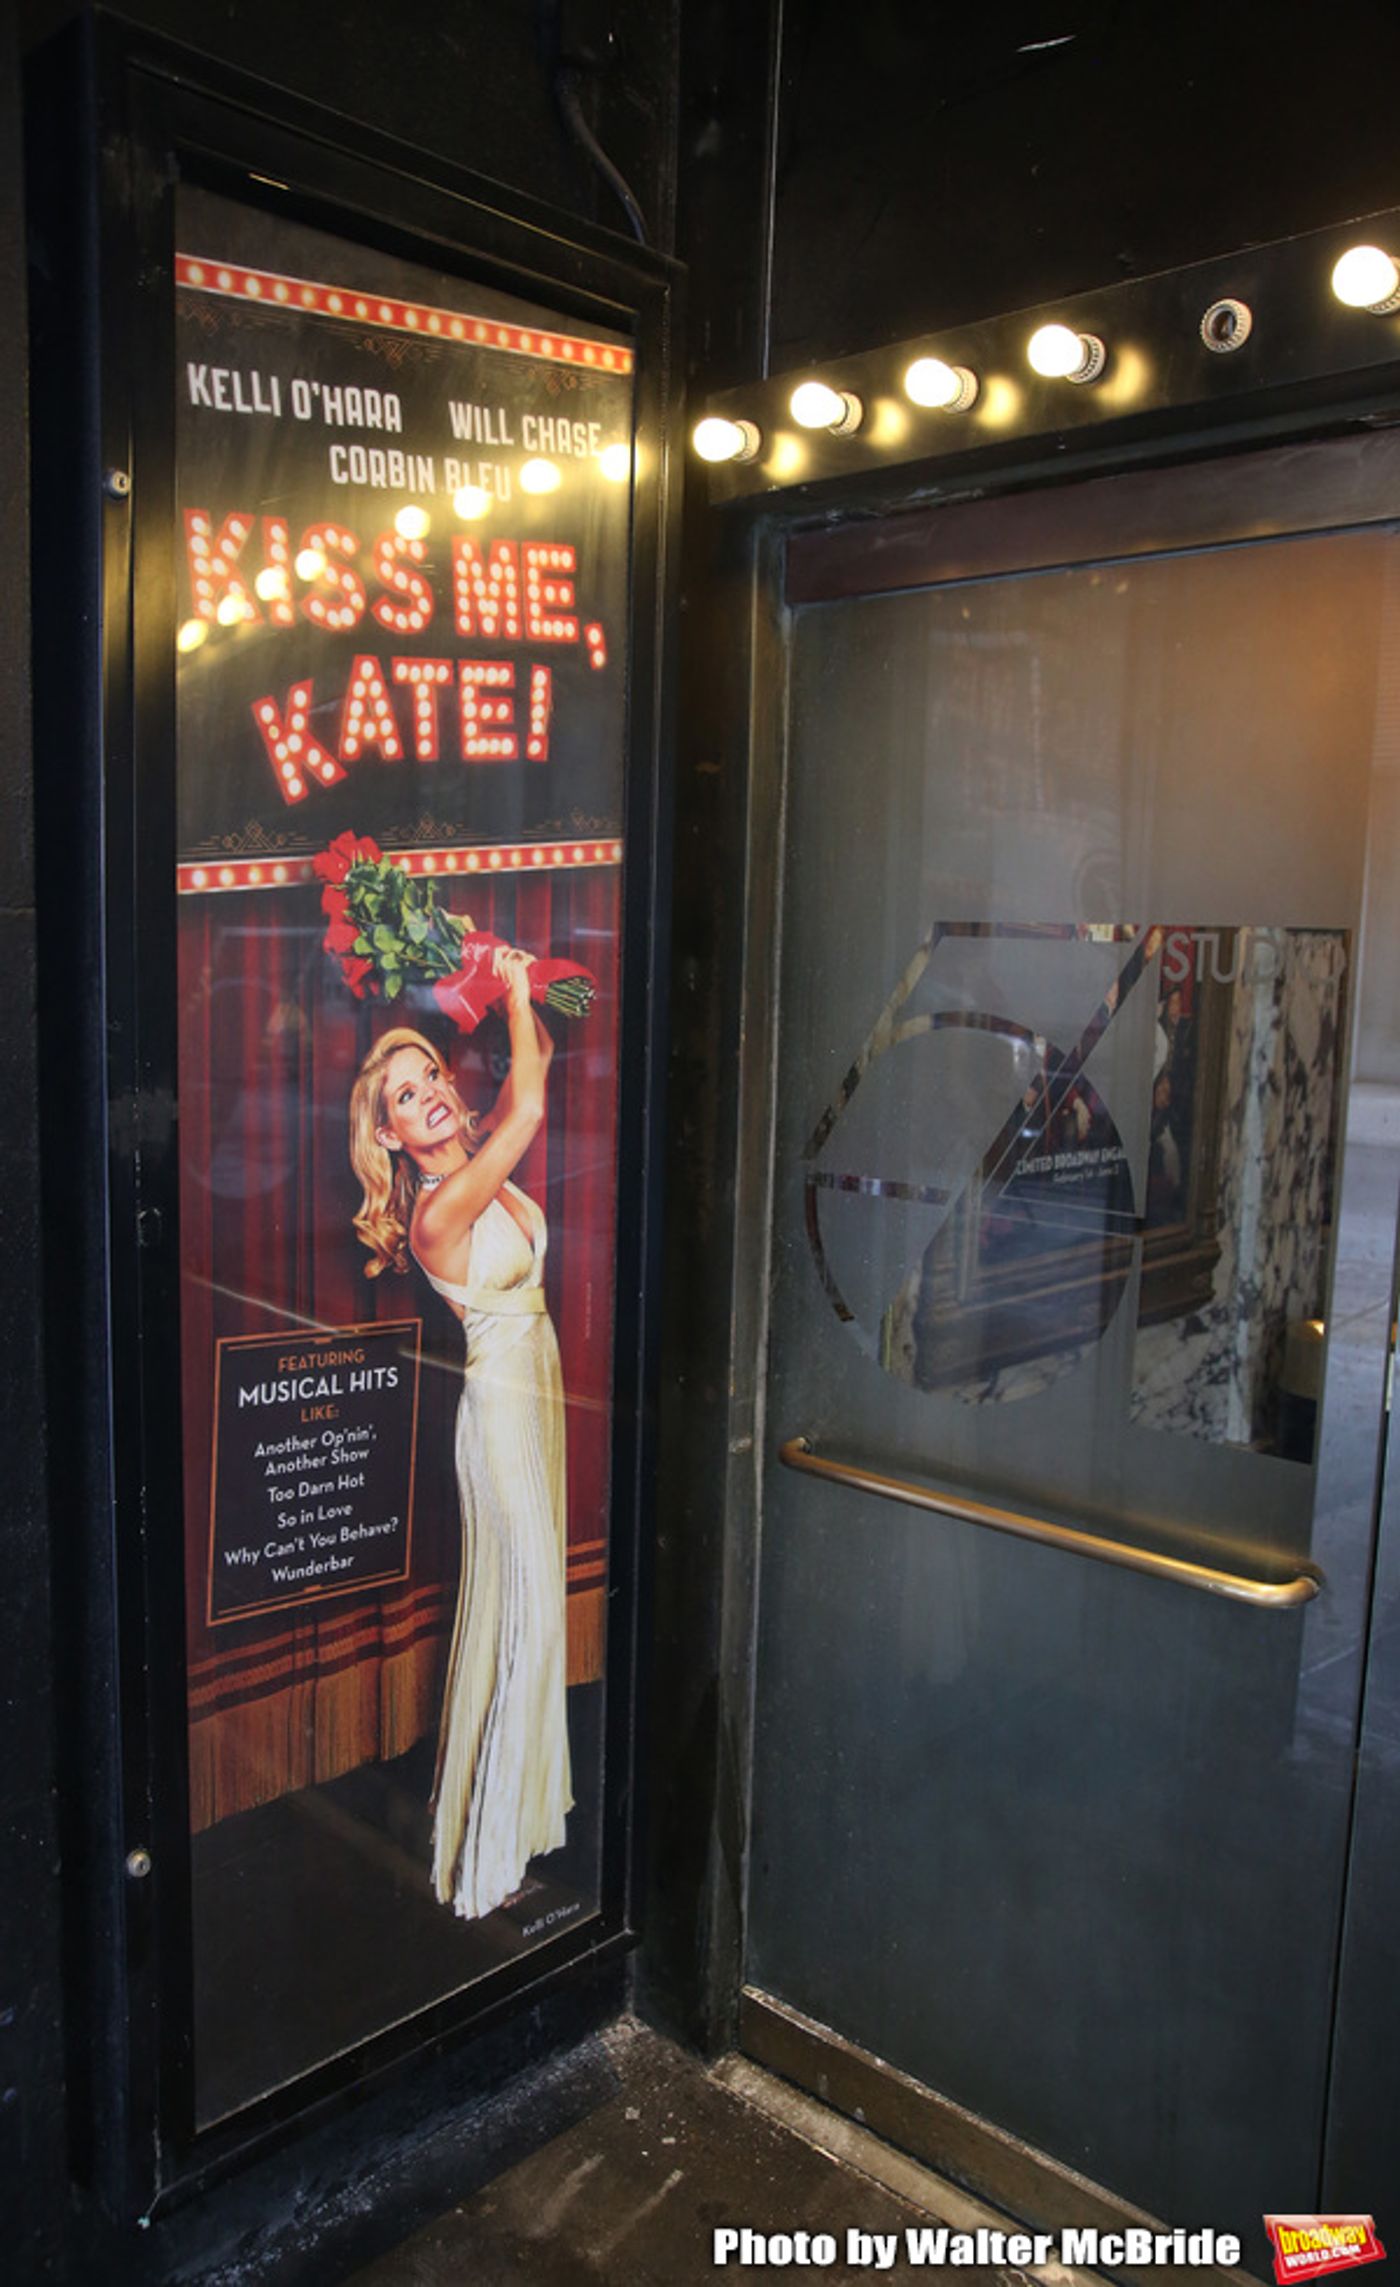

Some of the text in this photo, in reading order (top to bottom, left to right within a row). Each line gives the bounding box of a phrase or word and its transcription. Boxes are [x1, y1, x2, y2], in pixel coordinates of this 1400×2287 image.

[187, 362, 603, 458] KELLI O'HARA WILL CHASE
[329, 445, 512, 501] CORBIN BLEU
[183, 508, 606, 670] KISS ME,
[251, 653, 553, 807] KATE!
[277, 1348, 366, 1373] FEATURING
[238, 1366, 398, 1408] MUSICAL HITS
[300, 1403, 340, 1423] LIKE:
[254, 1435, 317, 1458] Another
[264, 1447, 370, 1477] Another Show
[267, 1472, 366, 1503] Too Darn Hot
[277, 1503, 353, 1529] So in Love
[224, 1516, 399, 1566] Why Can't You Behave?
[271, 1555, 355, 1582] Wunderbar
